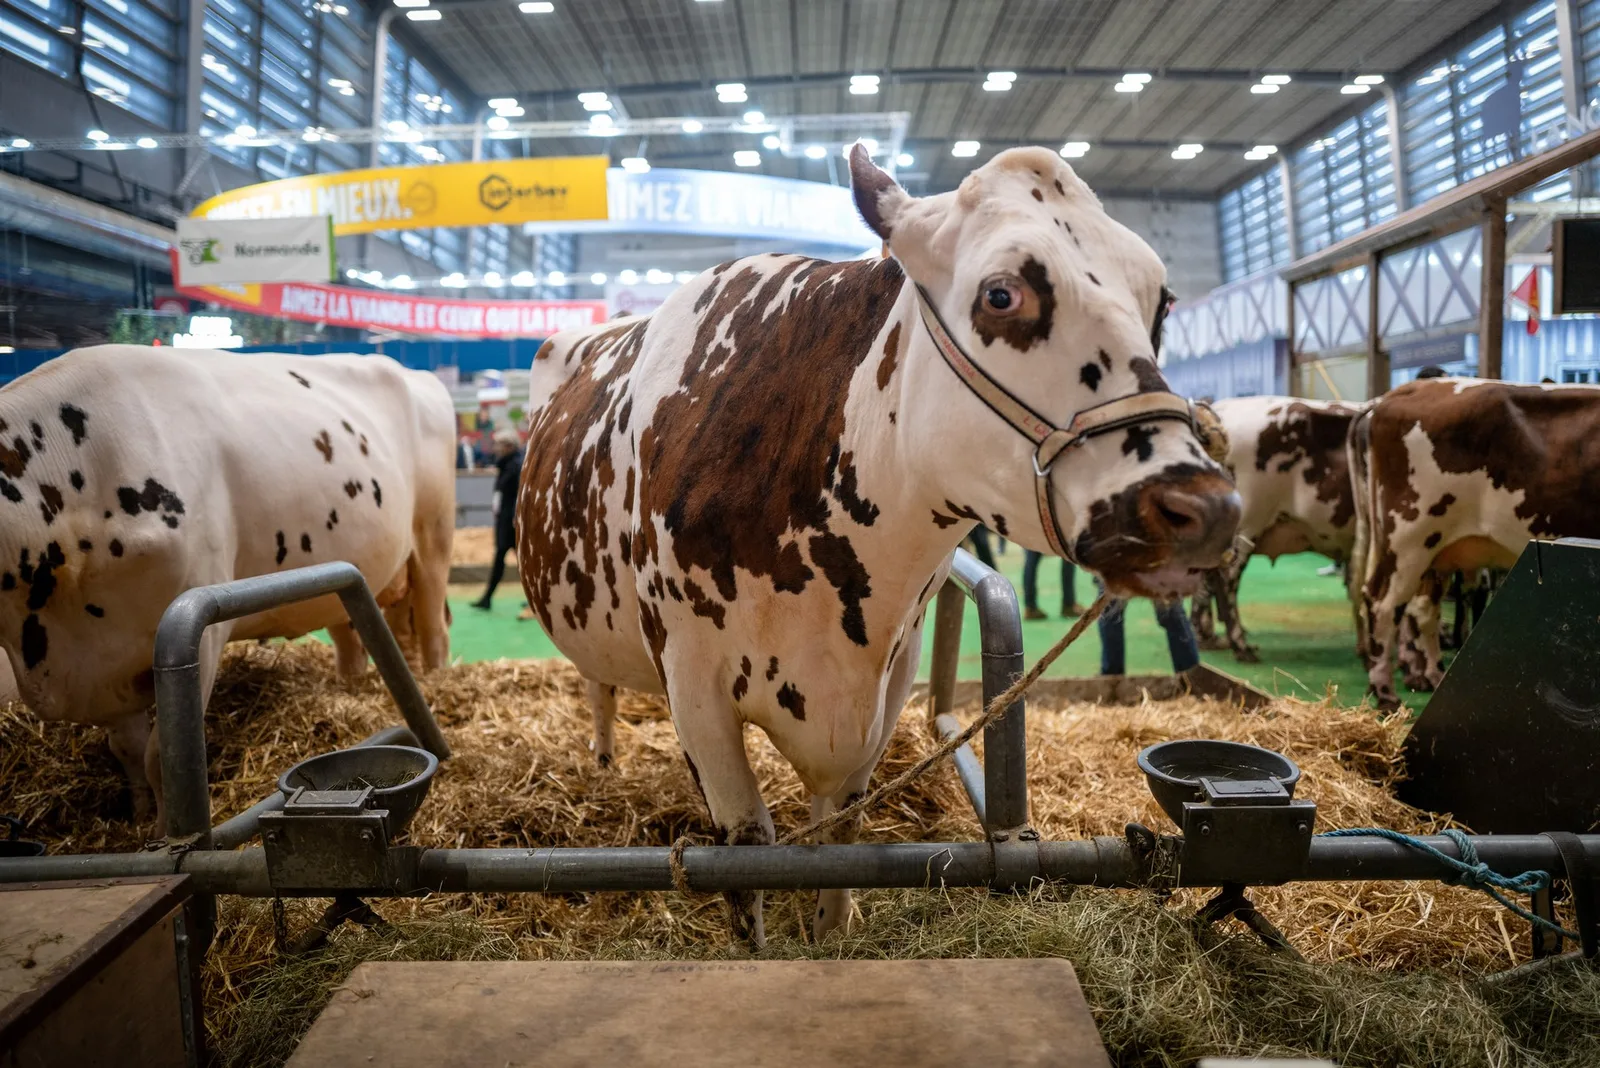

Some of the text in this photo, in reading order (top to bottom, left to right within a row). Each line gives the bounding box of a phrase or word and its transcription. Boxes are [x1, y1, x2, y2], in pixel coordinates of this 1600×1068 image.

[234, 239, 321, 258] Normande
[280, 284, 327, 319] AIMEZ
[328, 291, 350, 322] LA
[350, 294, 414, 328] VIANDE
[414, 302, 436, 331] ET
[438, 304, 484, 333] CEUX
[485, 305, 520, 335] QUI
[521, 306, 546, 334] LA
